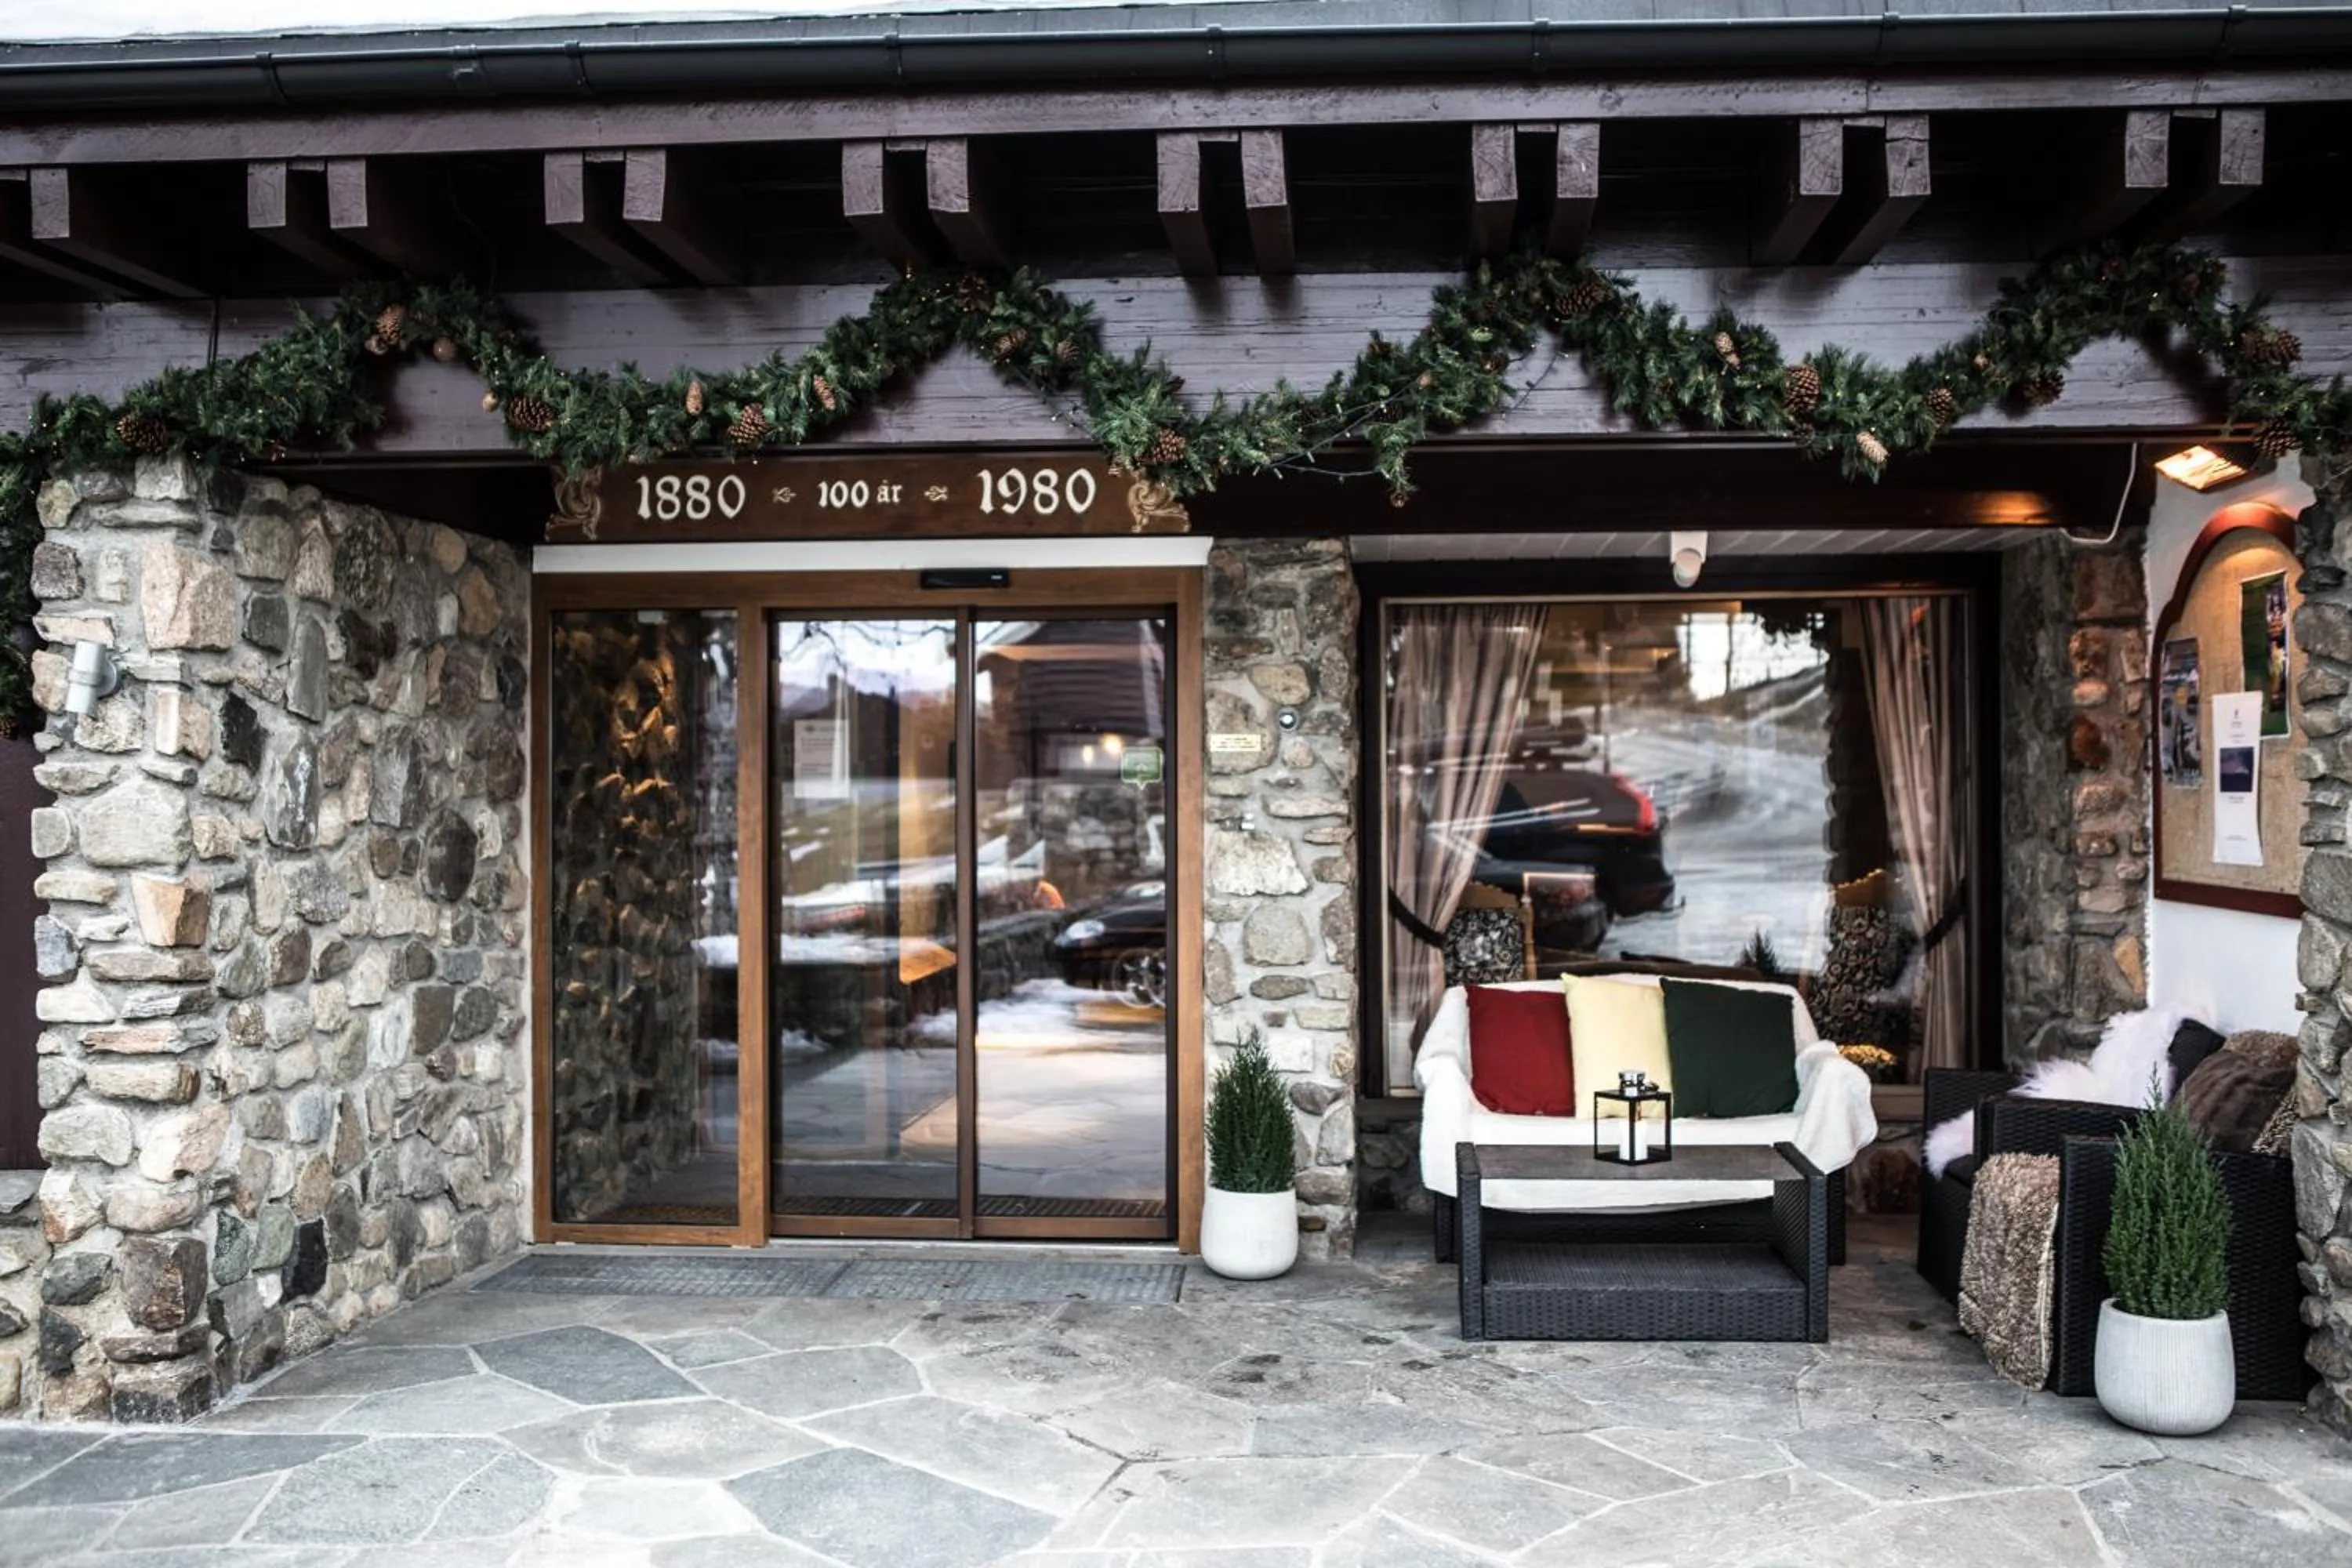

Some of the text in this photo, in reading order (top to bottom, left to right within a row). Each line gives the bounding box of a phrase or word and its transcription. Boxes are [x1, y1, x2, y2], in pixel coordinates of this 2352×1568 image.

[637, 468, 1096, 520] 1880 100 år 1980
